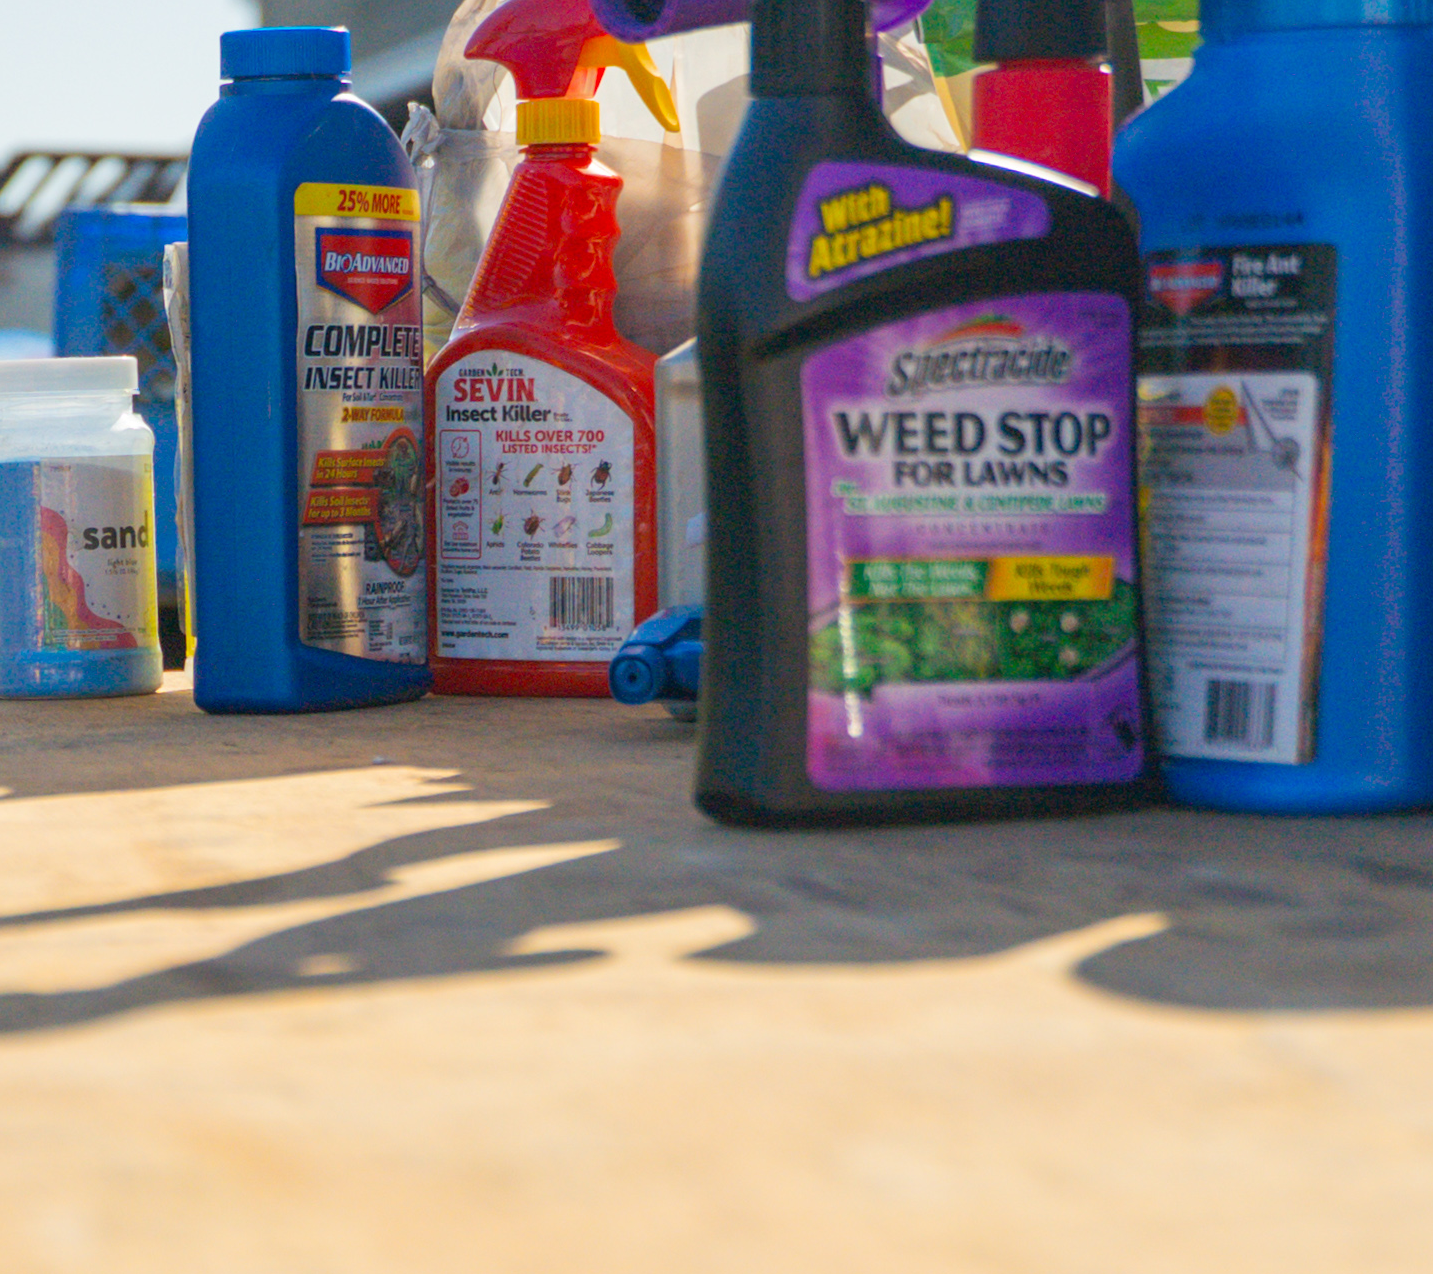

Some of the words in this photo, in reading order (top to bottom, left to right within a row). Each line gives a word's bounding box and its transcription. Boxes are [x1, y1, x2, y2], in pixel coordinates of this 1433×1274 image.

[337, 189, 369, 213] 25%
[371, 193, 400, 215] MORE
[821, 184, 891, 234] With
[808, 197, 952, 277] Atrazine!
[303, 324, 420, 358] COMPLETE
[303, 366, 375, 390] INSECT
[378, 366, 420, 390] KILLER
[458, 368, 485, 377] GARDEN
[887, 346, 1071, 397] Spectracide
[453, 377, 536, 403] SEVIN
[341, 408, 369, 422] 2-WAY
[370, 408, 404, 422] FORMULA
[446, 405, 497, 422] Insect
[502, 405, 551, 422] Killer
[496, 430, 531, 443] KILLS
[535, 430, 573, 443] OVER
[577, 430, 605, 443] 700
[835, 411, 986, 457] WEED
[997, 410, 1111, 457] STOP
[502, 444, 538, 454] LISTED
[336, 469, 358, 479] Hours
[893, 460, 955, 488] FOR
[963, 460, 1070, 488] LAWNS
[329, 495, 344, 505] Soil
[83, 510, 149, 550] sand
[365, 581, 405, 595] RAINPROOF
